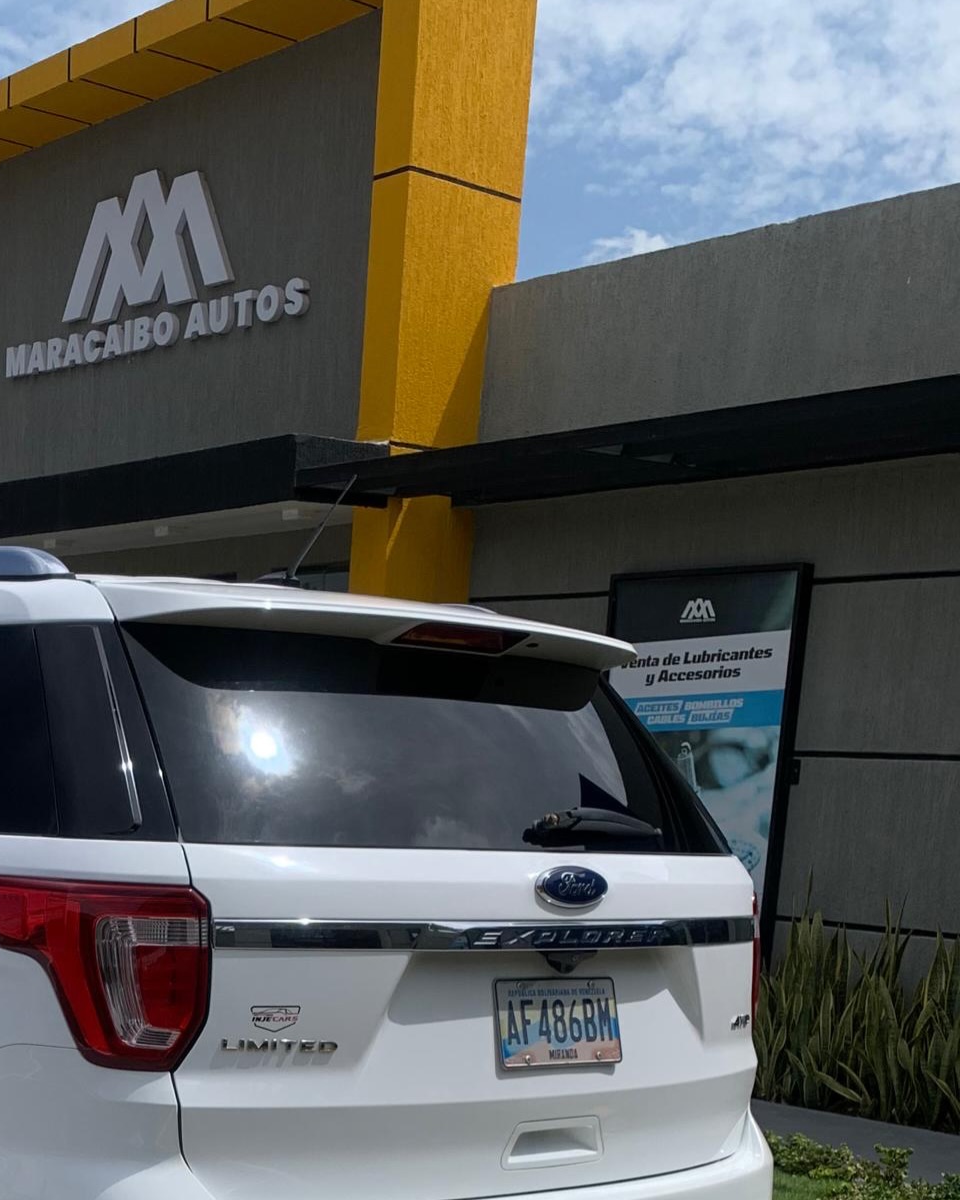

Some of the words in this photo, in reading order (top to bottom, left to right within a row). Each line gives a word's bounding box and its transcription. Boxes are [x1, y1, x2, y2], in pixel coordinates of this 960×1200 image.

[6, 311, 180, 379] MARACAIBO
[184, 277, 310, 340] AUTOS
[662, 653, 681, 666] de
[684, 647, 773, 665] Lubricantes
[645, 674, 655, 686] y
[658, 666, 741, 683] Accesorios
[637, 702, 680, 713] ACEITES
[558, 871, 596, 895] Ford
[473, 929, 668, 946] EXPLORER
[507, 998, 613, 1045] AF486BM
[221, 1038, 339, 1053] LIMITED
[549, 1048, 578, 1060] MIRANDA
